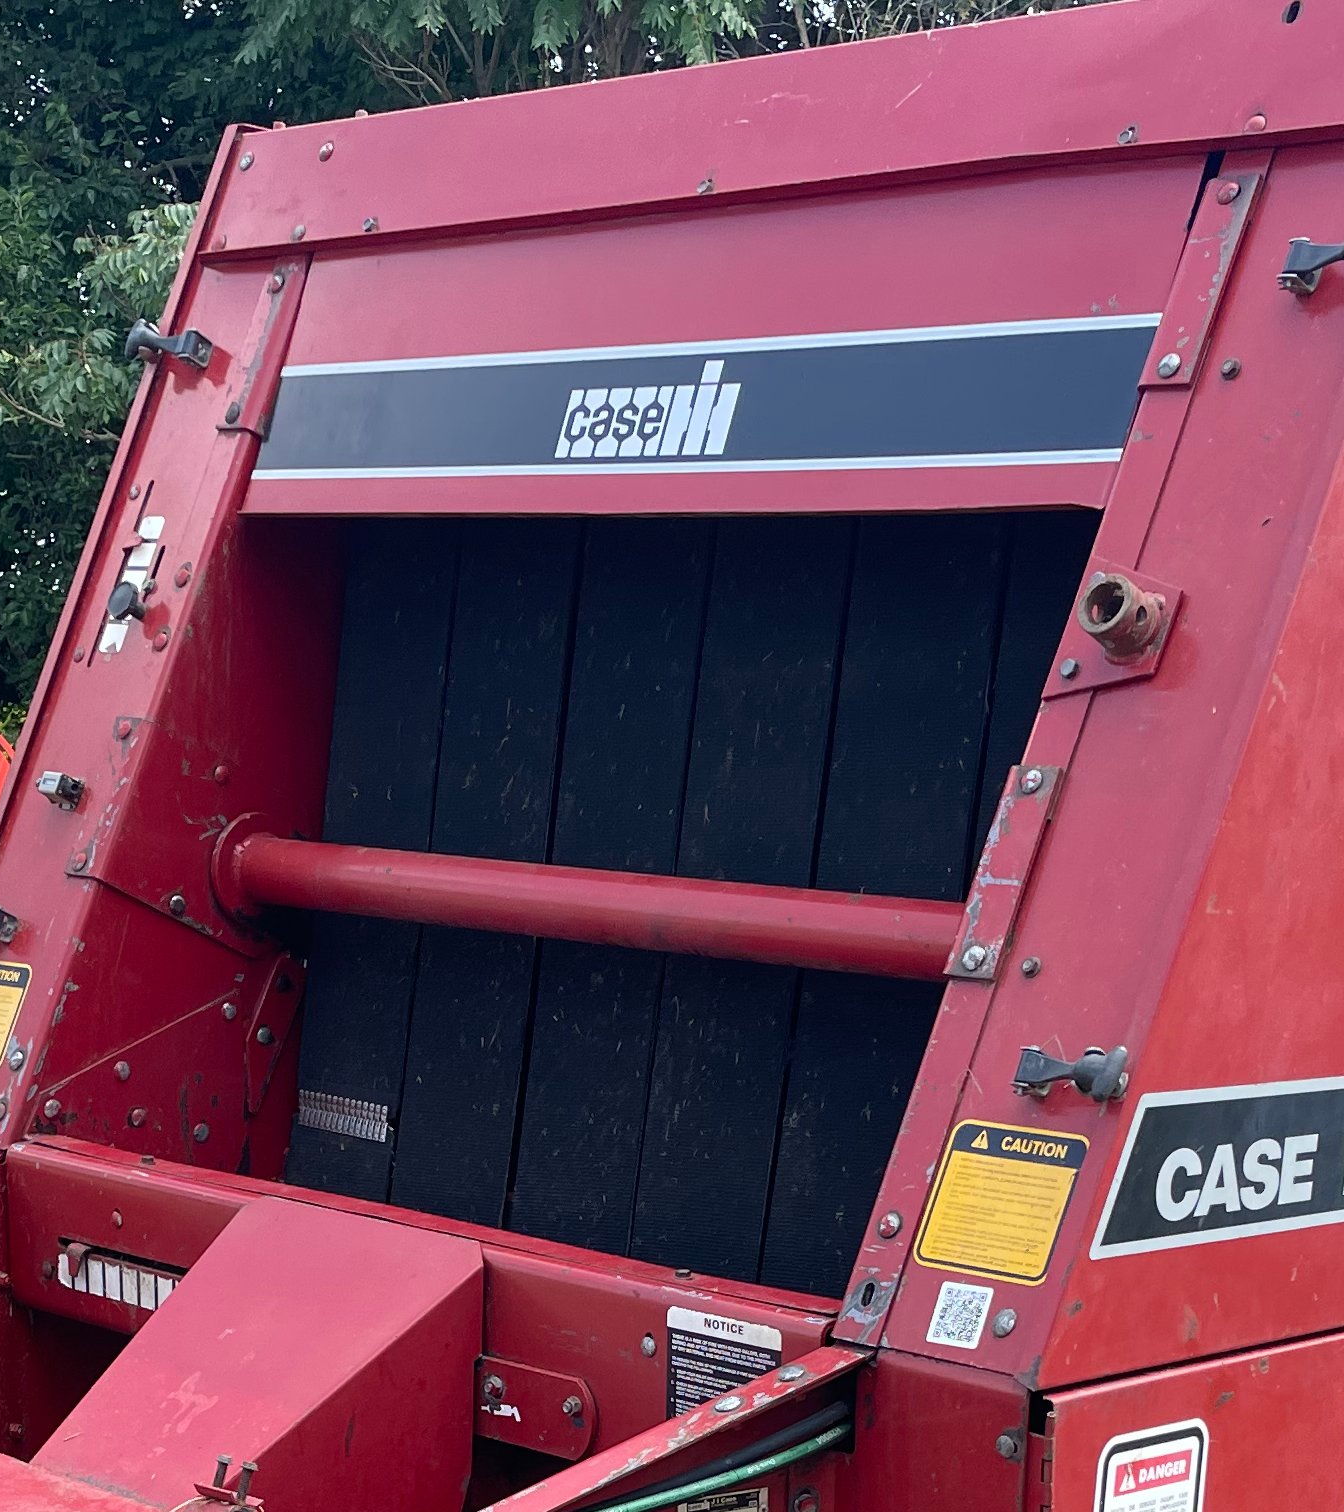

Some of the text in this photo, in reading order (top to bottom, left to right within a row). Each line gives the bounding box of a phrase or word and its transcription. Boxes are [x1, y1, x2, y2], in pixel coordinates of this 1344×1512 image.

[1001, 1136, 1068, 1160] CAUTION
[1156, 1133, 1318, 1222] CASE
[704, 1317, 744, 1336] NOTICE
[1138, 1459, 1187, 1484] DANGER
